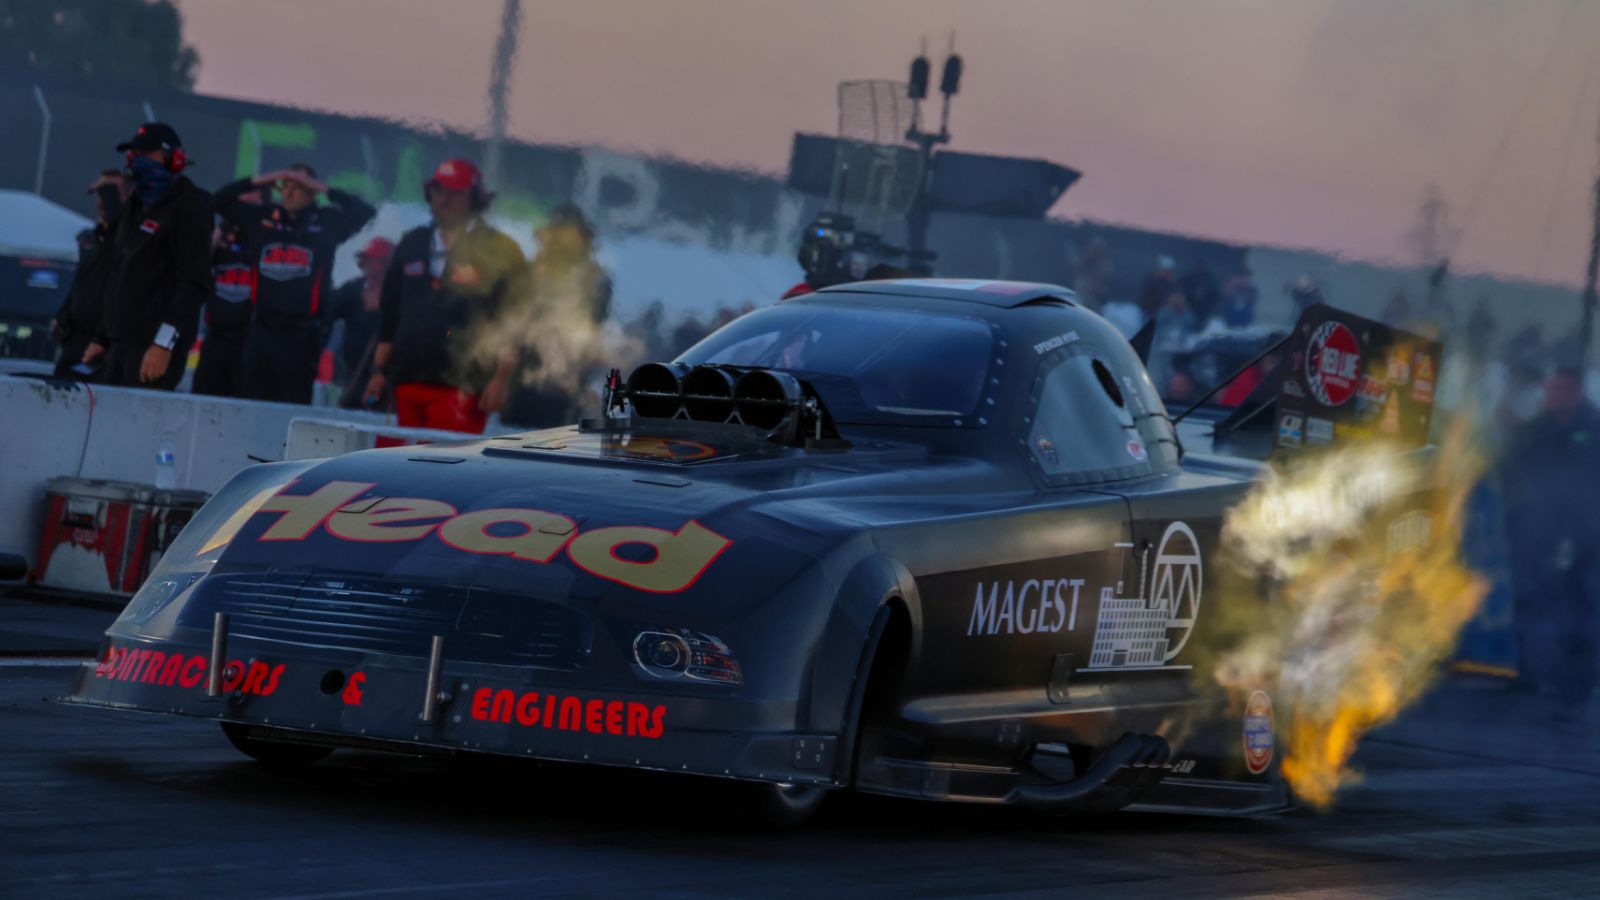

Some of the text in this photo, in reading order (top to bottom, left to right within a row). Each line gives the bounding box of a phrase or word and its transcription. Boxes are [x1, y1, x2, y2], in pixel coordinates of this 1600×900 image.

[196, 478, 734, 593] Head
[967, 578, 1085, 637] MAGEST
[96, 644, 667, 740] CONTRACORS & ENGINEERS
